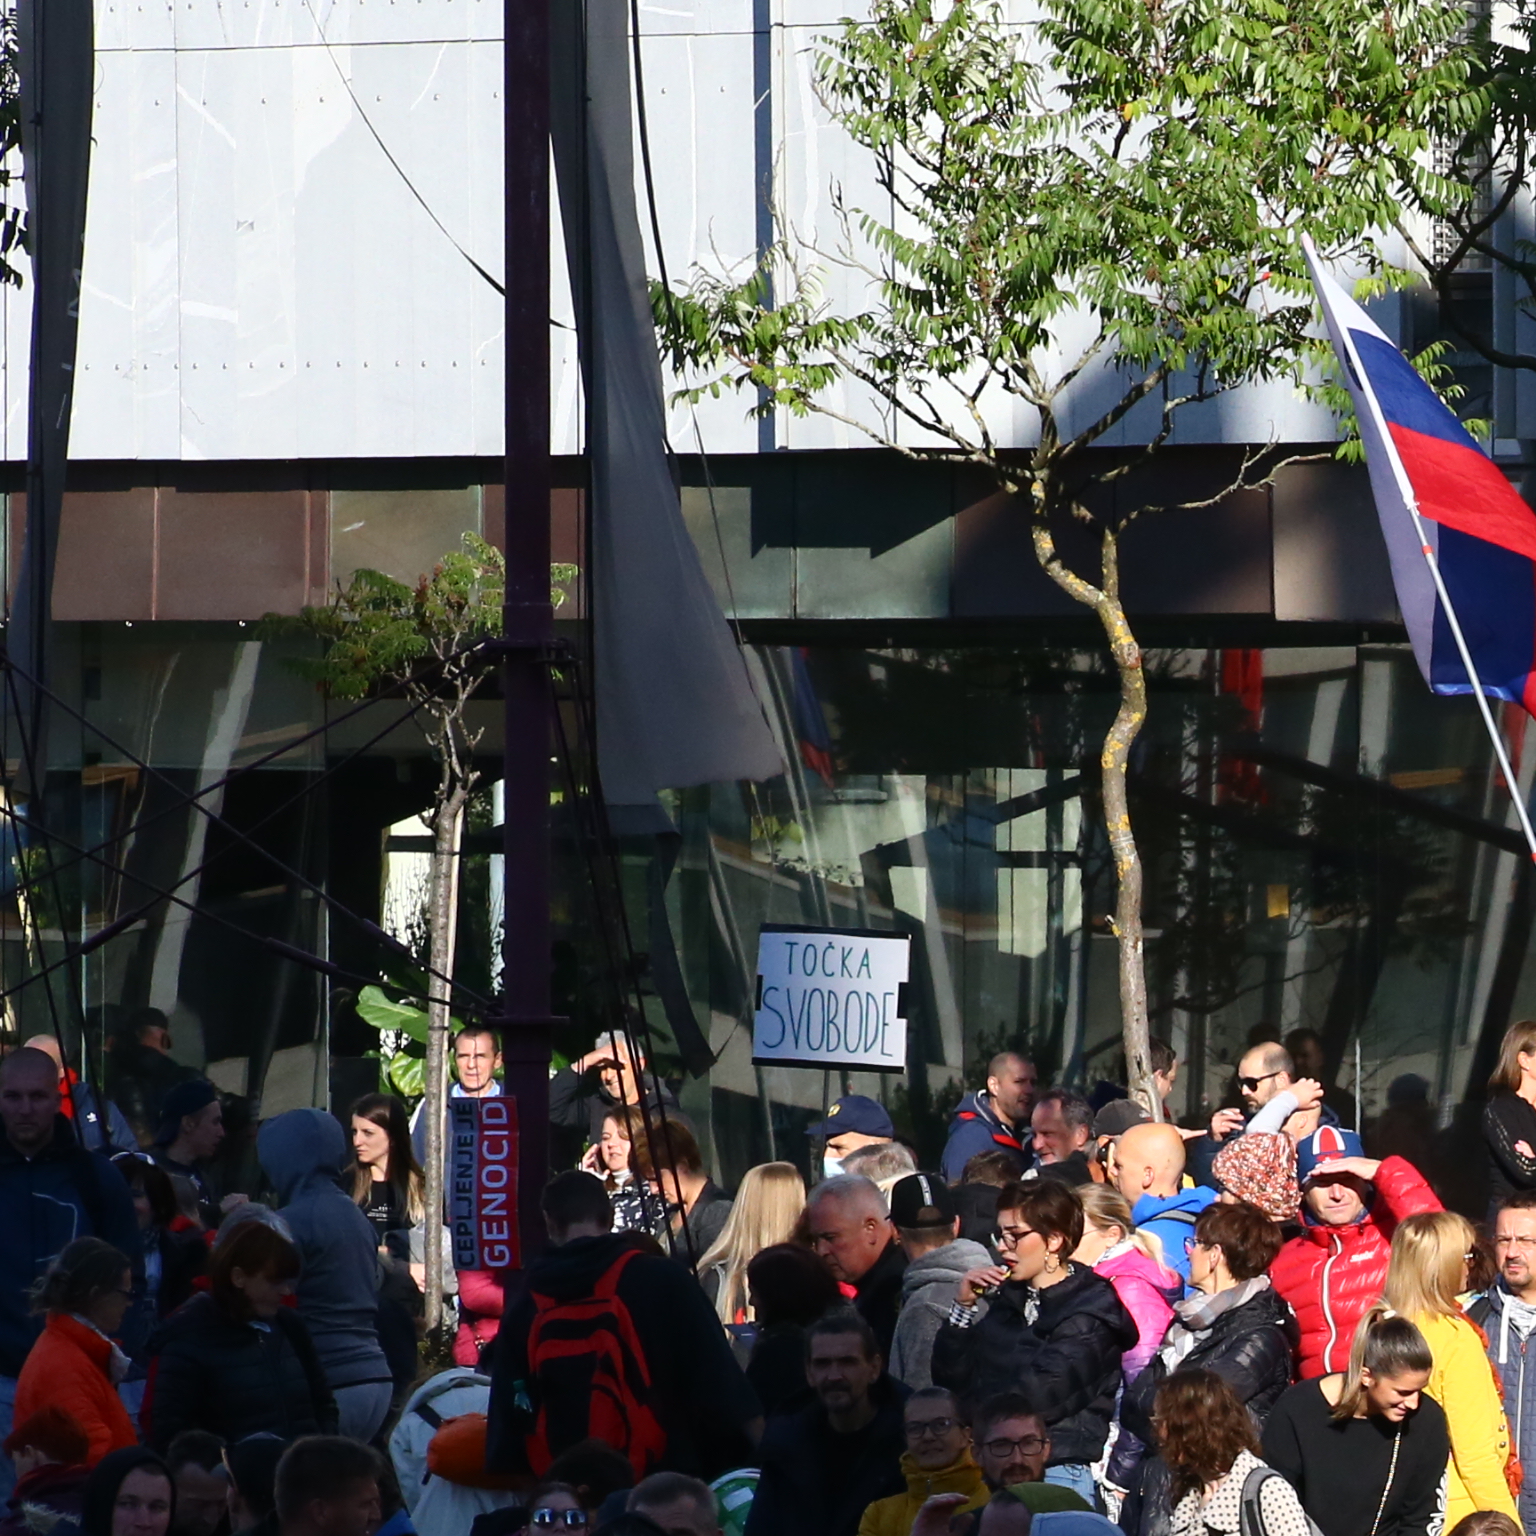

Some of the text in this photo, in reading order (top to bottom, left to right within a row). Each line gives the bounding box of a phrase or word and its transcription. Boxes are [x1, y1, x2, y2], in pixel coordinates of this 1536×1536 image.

[785, 941, 872, 980] TOČKA
[762, 986, 896, 1057] SVOBODE
[481, 1101, 511, 1268] GENOCID
